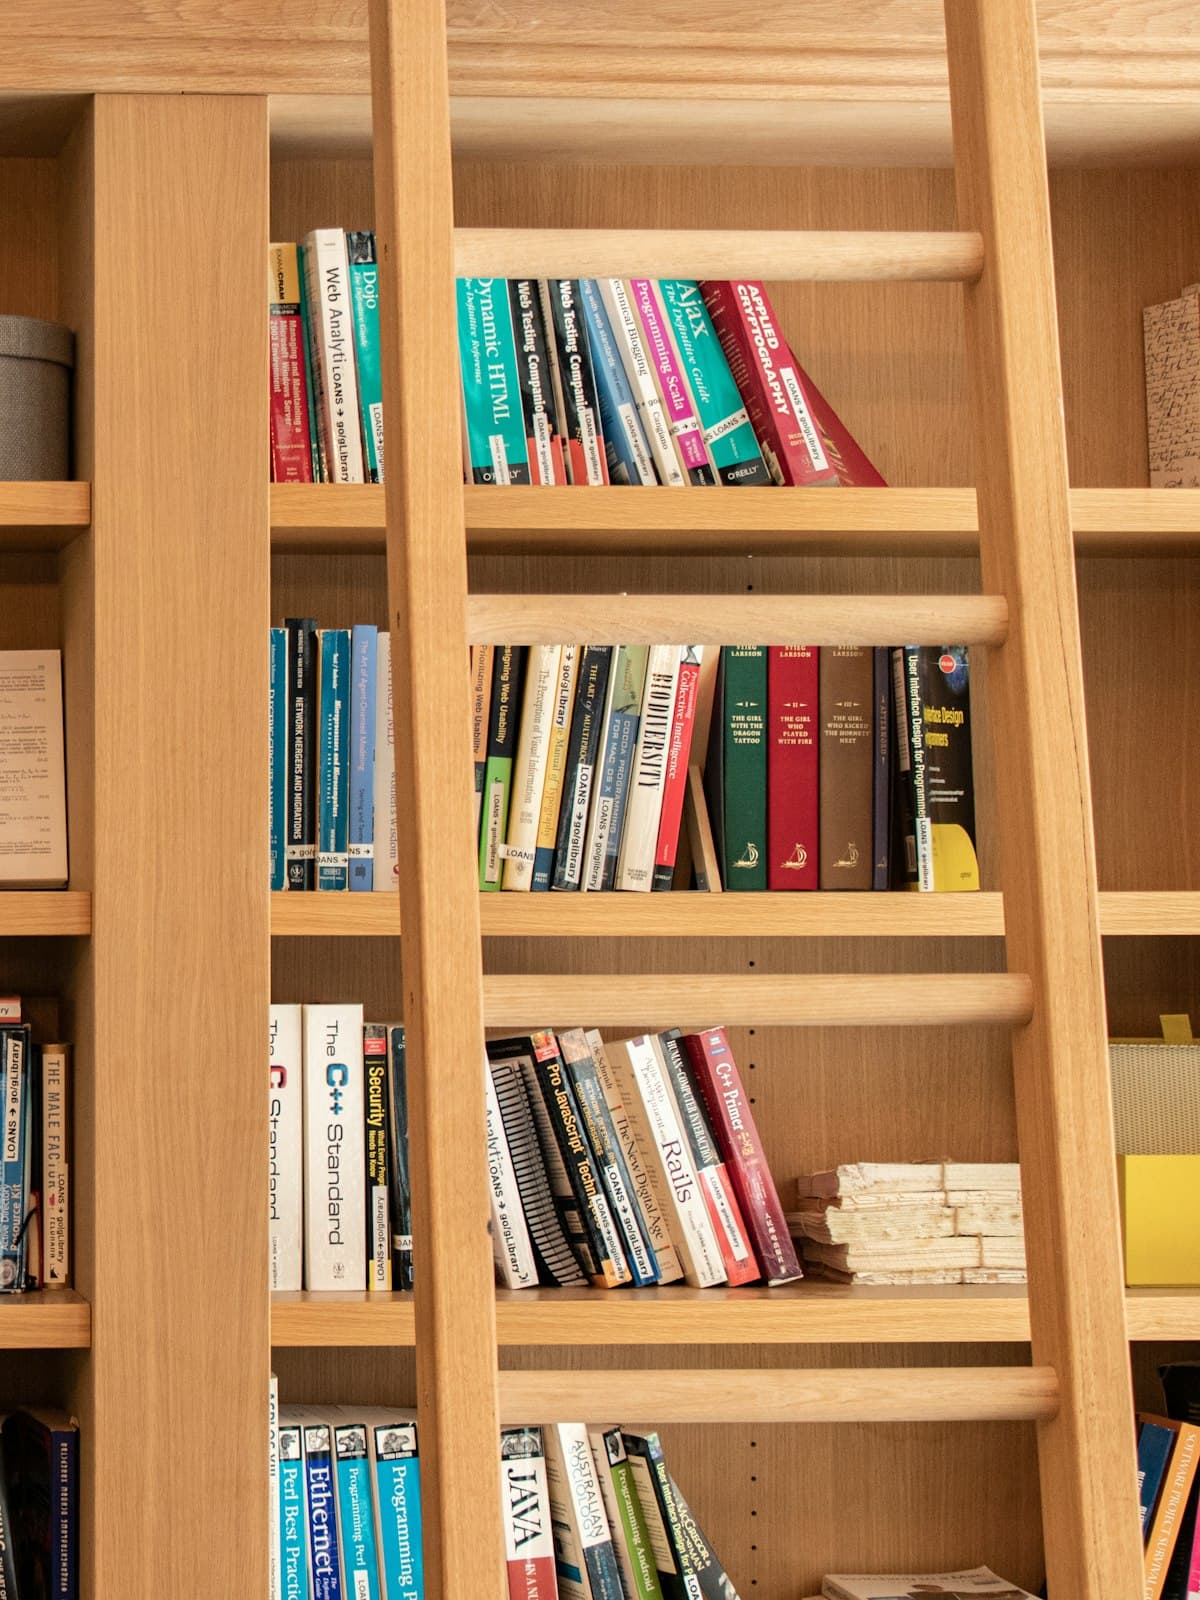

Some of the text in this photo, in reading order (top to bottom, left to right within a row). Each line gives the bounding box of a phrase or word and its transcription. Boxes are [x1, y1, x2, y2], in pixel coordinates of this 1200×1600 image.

[326, 267, 339, 302] Web
[363, 271, 376, 309] Dojo
[518, 282, 536, 352] Web Testing
[559, 282, 578, 352] Web Testing
[638, 282, 684, 411] Programming Scala
[748, 285, 779, 351] APPLIED
[629, 329, 647, 374] Blogging
[738, 285, 789, 416] CRYPTOGRAPHY
[333, 366, 344, 406] LOANS
[487, 364, 510, 425] HTML
[788, 378, 802, 409] LOANS
[496, 682, 510, 744] Web Usability
[677, 671, 690, 718] Collective
[909, 655, 921, 749] User Interface Design
[474, 714, 482, 753] Usability
[293, 697, 304, 840] NETWORK MERGERS AND MIGRATIONS
[578, 766, 589, 806] LOANS
[600, 800, 609, 829] LOANS
[48, 1060, 59, 1129] THE MALE
[367, 1067, 384, 1127] Security
[547, 1063, 584, 1153] Pro JavaScript
[724, 1089, 743, 1131] Primer
[8, 1119, 17, 1158] LOANS
[327, 1021, 348, 1246] The C++ Standard
[608, 1166, 625, 1202] LOANS
[636, 1170, 654, 1211] Digital
[662, 1139, 692, 1204] Rails
[596, 1198, 609, 1225] LOANS
[284, 1468, 299, 1538] Perl Best
[508, 1468, 542, 1552] JAVA
[575, 1440, 604, 1538] AUSTRALIAN
[618, 1469, 640, 1547] Programming
[309, 1468, 332, 1577] Ethernet
[392, 1467, 412, 1586] Programming
